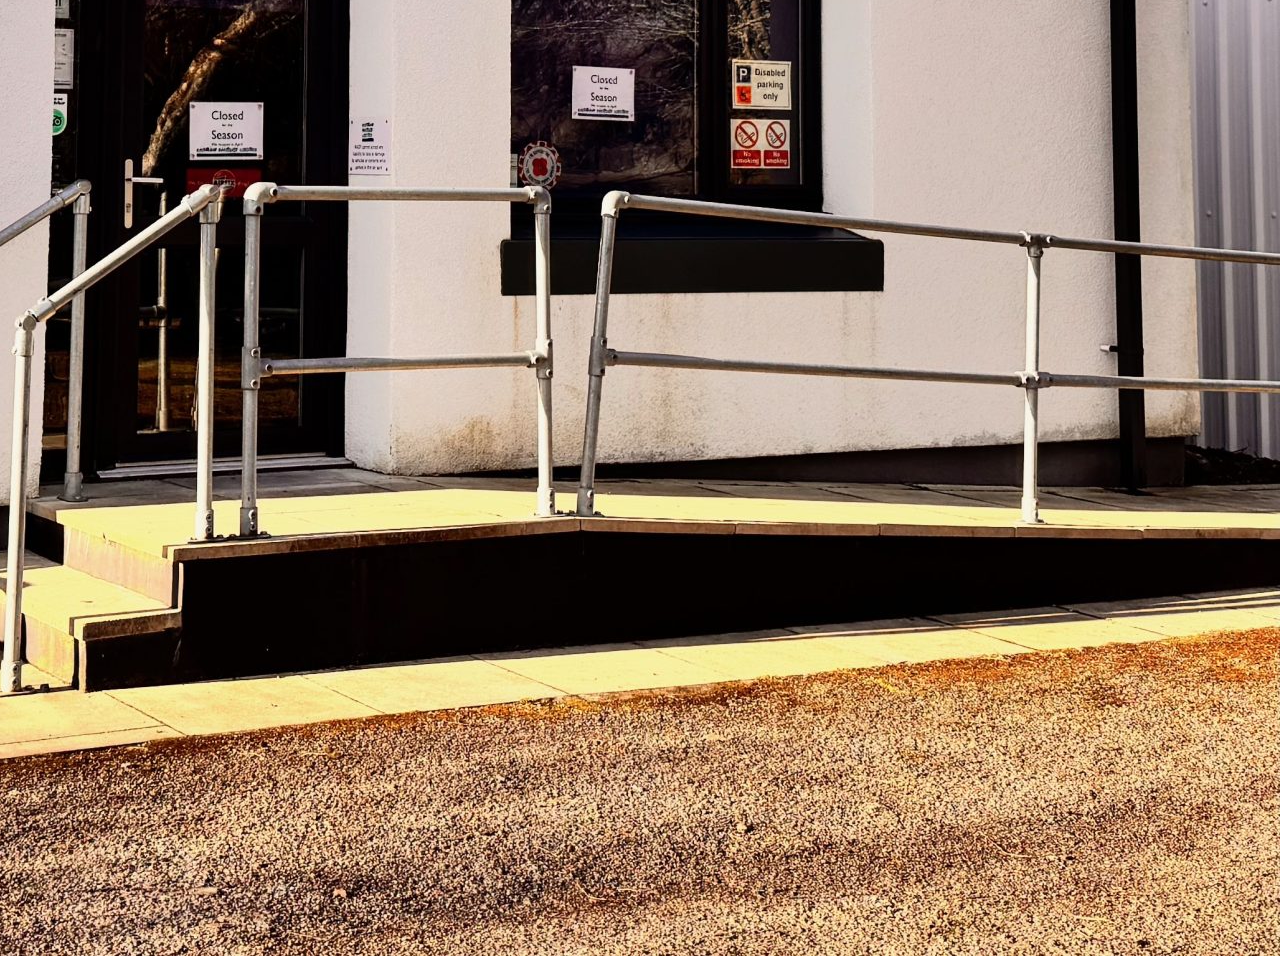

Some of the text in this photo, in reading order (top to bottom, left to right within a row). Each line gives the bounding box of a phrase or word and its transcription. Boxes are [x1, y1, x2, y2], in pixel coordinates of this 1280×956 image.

[739, 68, 748, 81] P
[754, 68, 786, 77] Disabled
[590, 74, 618, 85] Closed
[757, 81, 784, 91] parking
[590, 92, 618, 102] Season
[763, 93, 779, 102] only
[211, 110, 244, 121] Closed
[211, 129, 244, 140] Season
